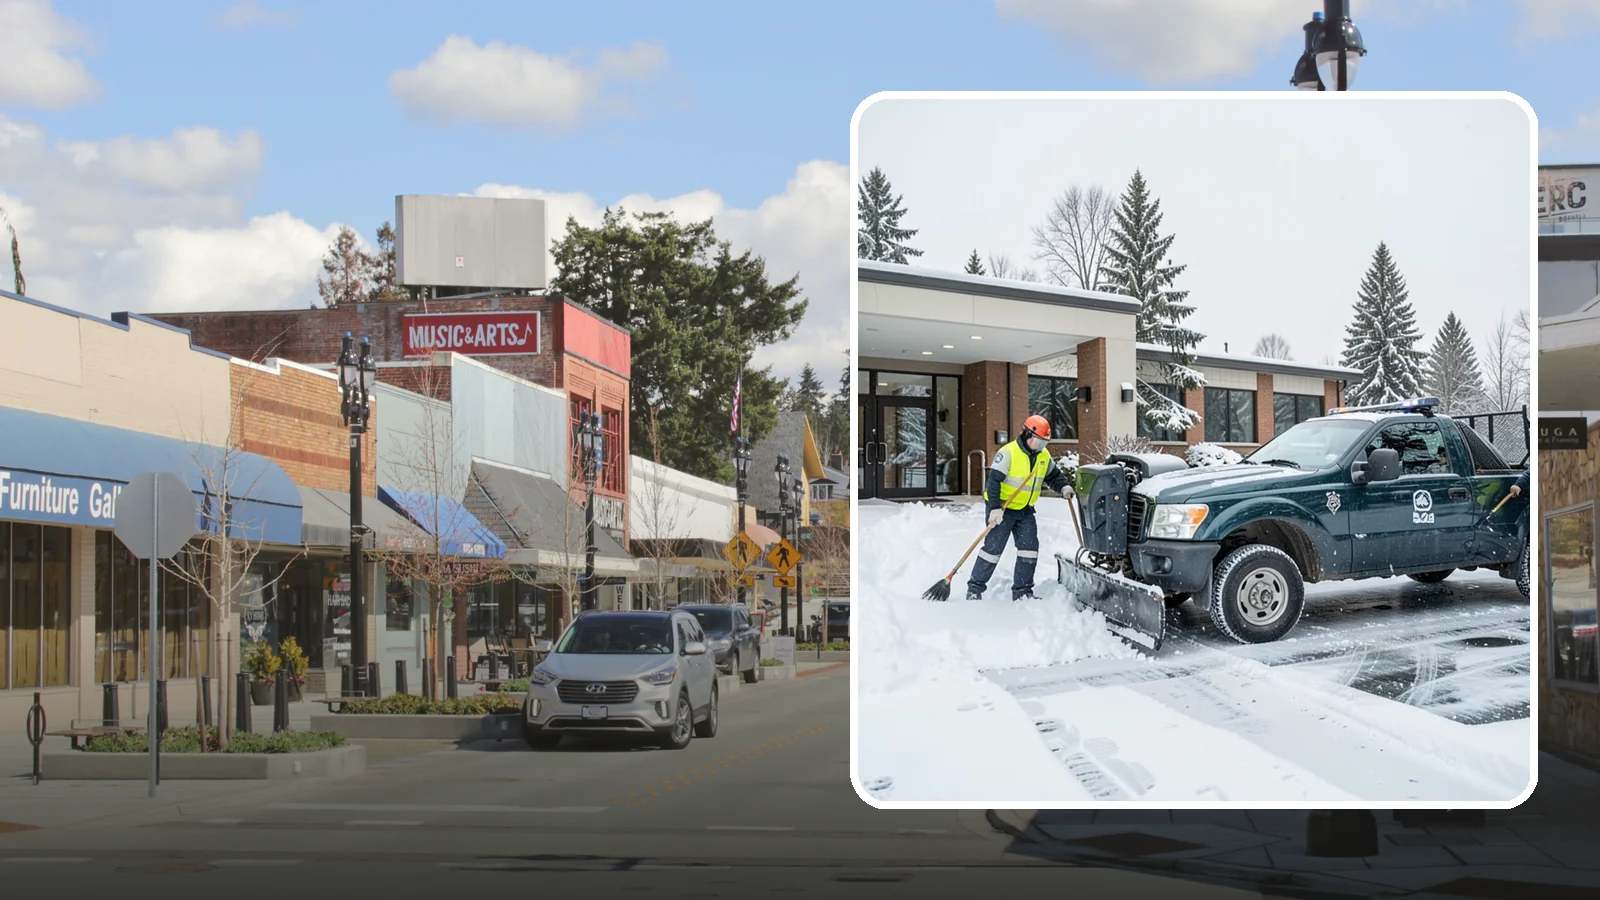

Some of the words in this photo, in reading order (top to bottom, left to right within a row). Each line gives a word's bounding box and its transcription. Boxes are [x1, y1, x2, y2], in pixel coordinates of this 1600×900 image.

[408, 323, 519, 349] MUSIC&ARTS
[1540, 427, 1577, 437] UGA
[0, 471, 79, 516] Furniture
[89, 482, 122, 519] Gal
